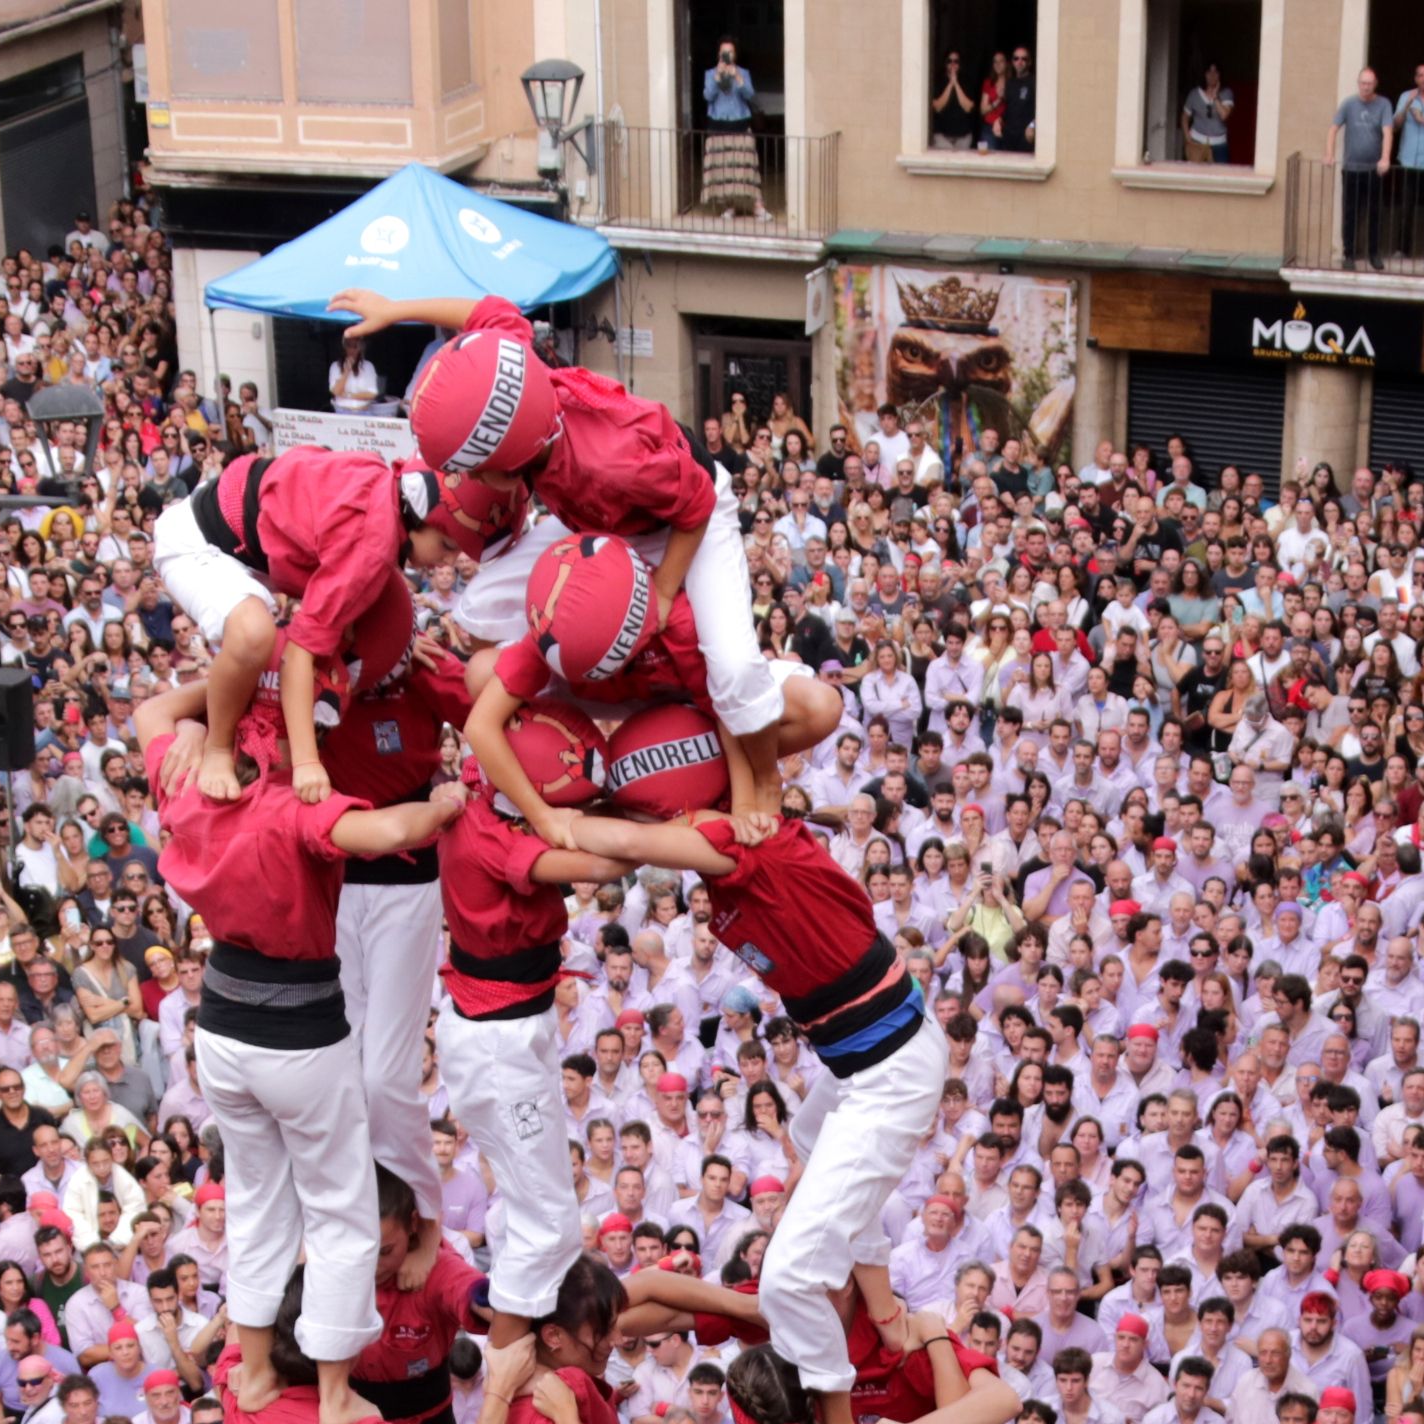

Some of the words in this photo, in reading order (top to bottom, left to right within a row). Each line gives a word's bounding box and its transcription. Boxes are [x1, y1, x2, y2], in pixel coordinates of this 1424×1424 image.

[1253, 349, 1292, 358] BRUNCH
[1302, 352, 1337, 363] COFFEE
[1348, 356, 1375, 366] GRILL
[463, 343, 525, 457] VENDRELL
[609, 735, 721, 787] VENDRELL
